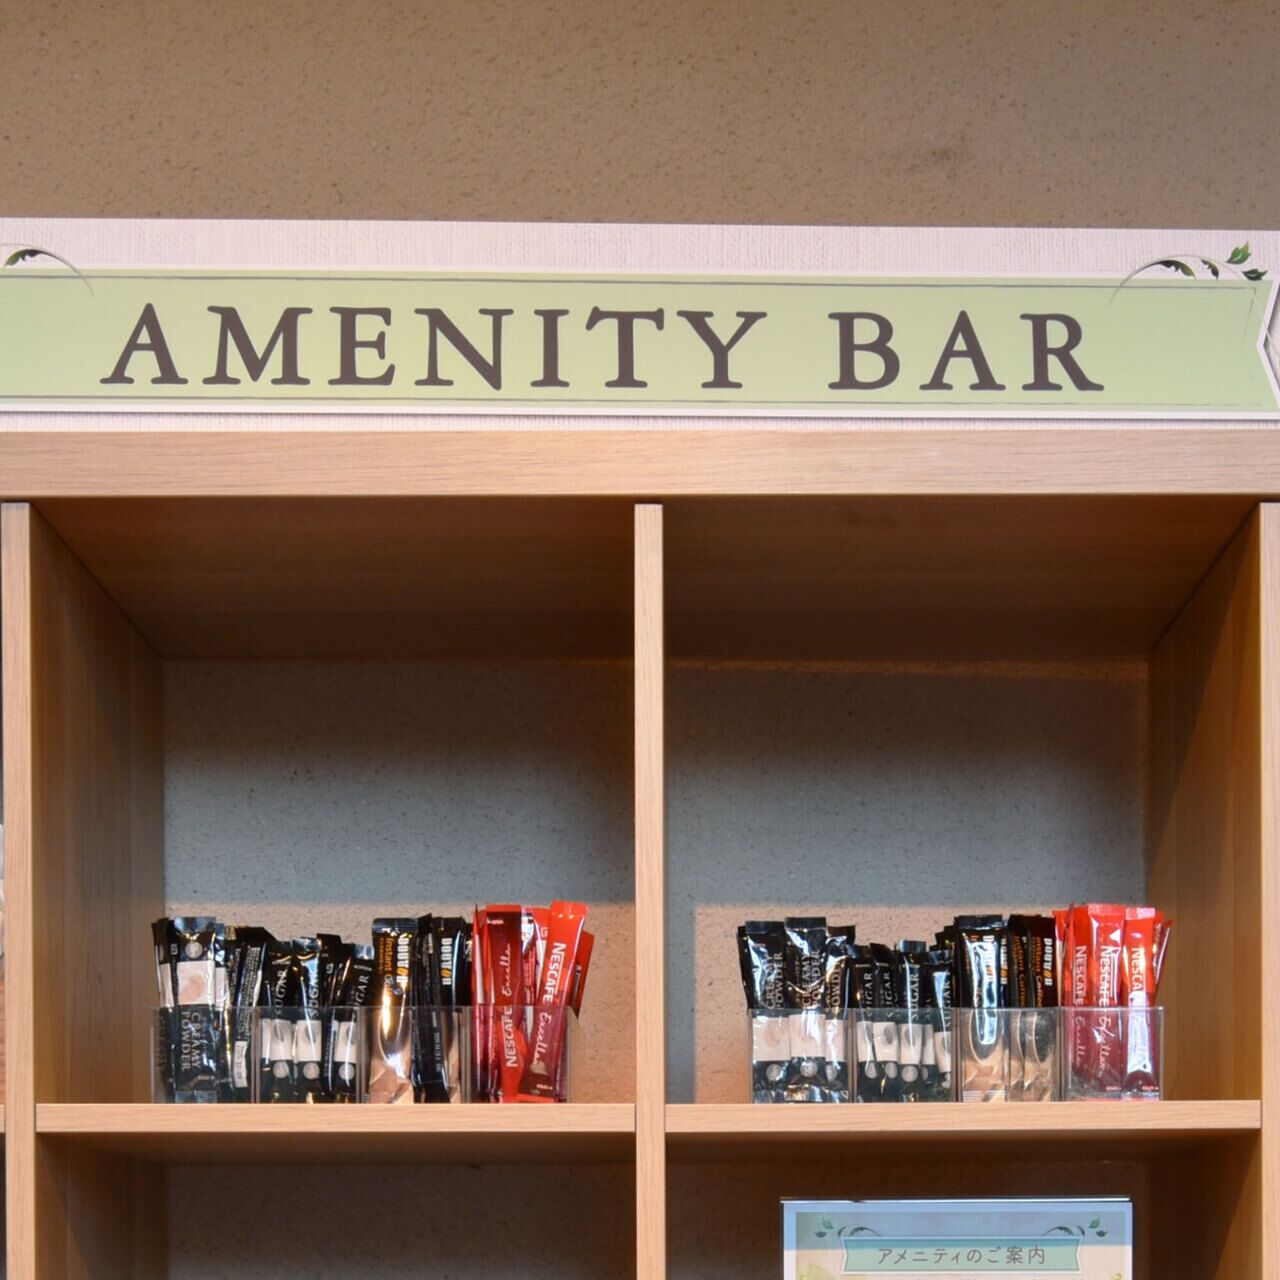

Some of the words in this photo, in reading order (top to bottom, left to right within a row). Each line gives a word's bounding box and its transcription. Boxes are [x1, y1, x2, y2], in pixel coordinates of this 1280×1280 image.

[99, 302, 769, 391] AMENITY
[827, 309, 1105, 392] BAR
[384, 937, 394, 971] Instant
[1043, 937, 1053, 986] DOUTOR
[884, 972, 895, 1018] SUGAR
[910, 972, 919, 1021] SUGAR
[181, 1011, 191, 1072] POWDER
[190, 1012, 201, 1069] CREAMY
[877, 1245, 1046, 1265] アメニティのご案内
